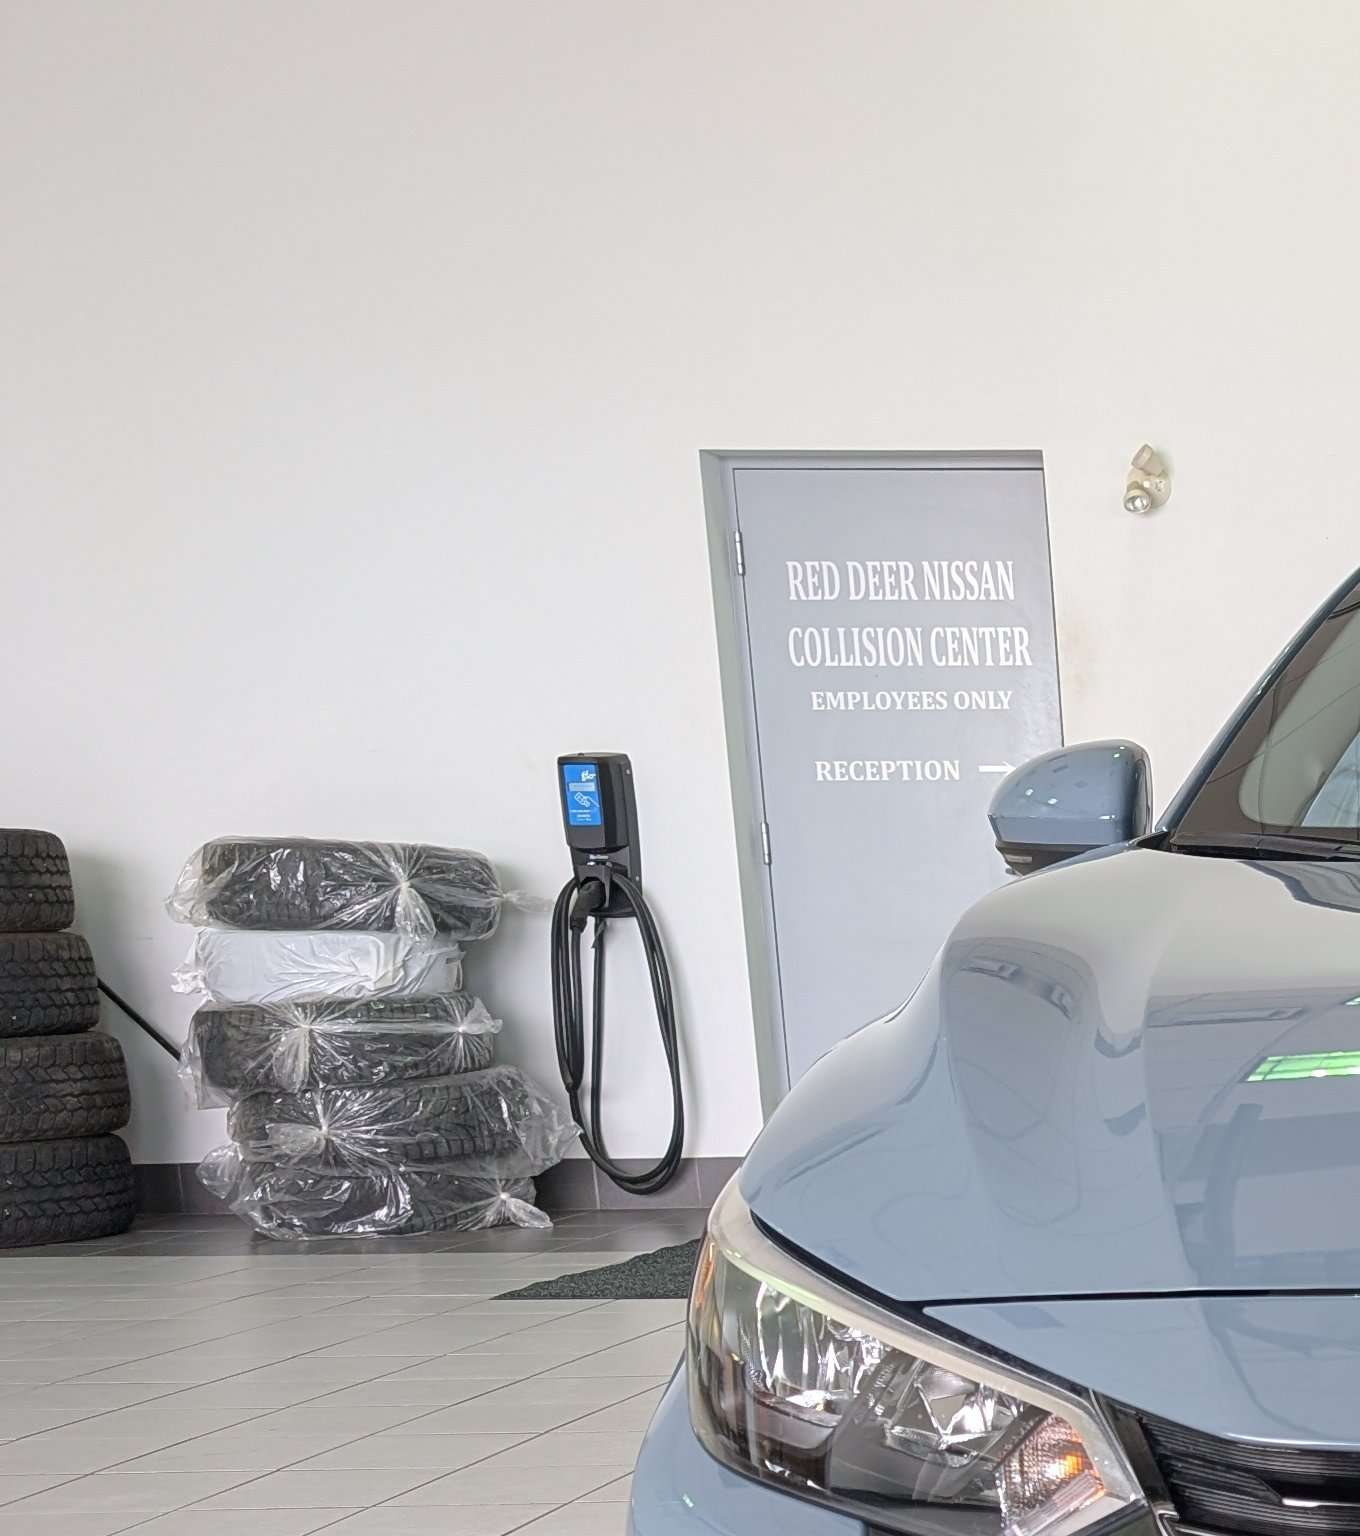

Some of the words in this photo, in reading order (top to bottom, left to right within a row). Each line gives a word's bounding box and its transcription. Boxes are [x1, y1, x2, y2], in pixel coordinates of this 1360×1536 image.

[785, 560, 841, 601] RED
[846, 560, 921, 601] DEER
[923, 560, 1016, 601] NISSAN
[788, 627, 924, 667] COLLISION
[930, 627, 1033, 667] CENTER
[811, 691, 948, 711] EMPLOYEES
[953, 690, 1013, 711] ONLY
[815, 760, 960, 781] RECEPTION
